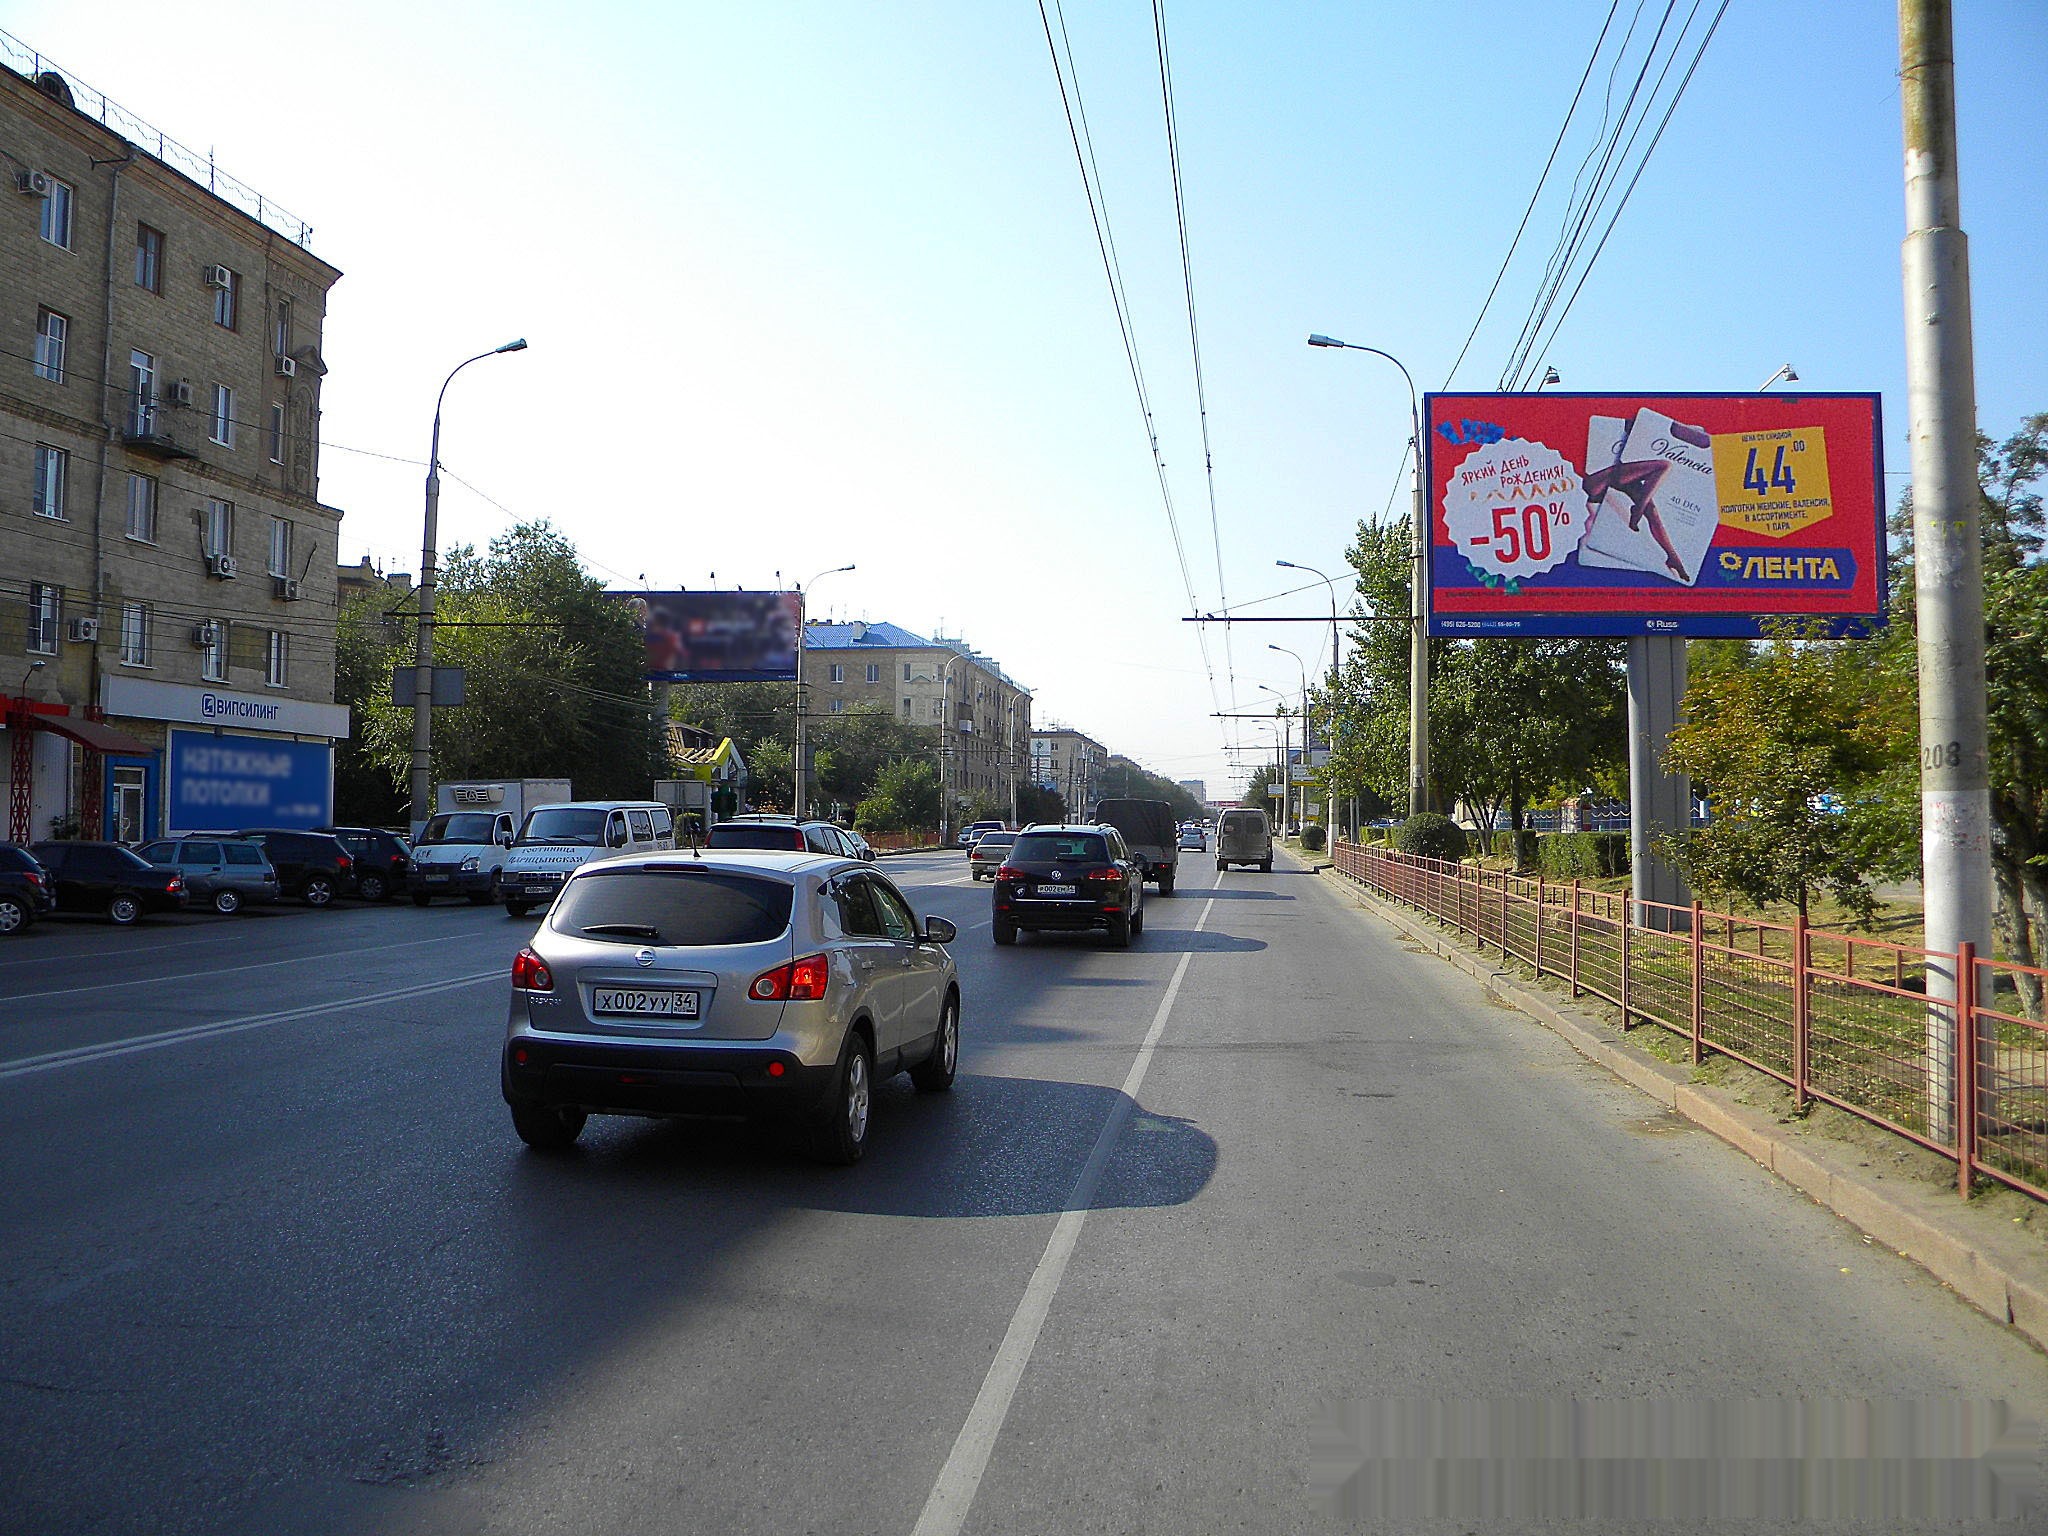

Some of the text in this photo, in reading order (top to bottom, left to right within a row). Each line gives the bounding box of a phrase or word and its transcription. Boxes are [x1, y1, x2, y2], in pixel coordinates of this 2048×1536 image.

[1651, 438, 1712, 474] Valencia
[1461, 455, 1529, 486] ЯРКИЙ ДЕНЬ
[1683, 499, 1700, 512] DEN
[1721, 503, 1755, 513] КОЛГОТКИ
[1773, 522, 1790, 531] ПАРА
[1743, 556, 1840, 579] ЛЕНТА
[1656, 620, 1678, 628] Russ
[217, 699, 279, 720] ВИПСИЛИНГ
[1925, 741, 1960, 770] 208
[522, 846, 575, 854] ГОСТИНИЦА
[508, 856, 583, 864] ЦАРИЦЫНСКАЯ
[675, 993, 692, 1008] 34
